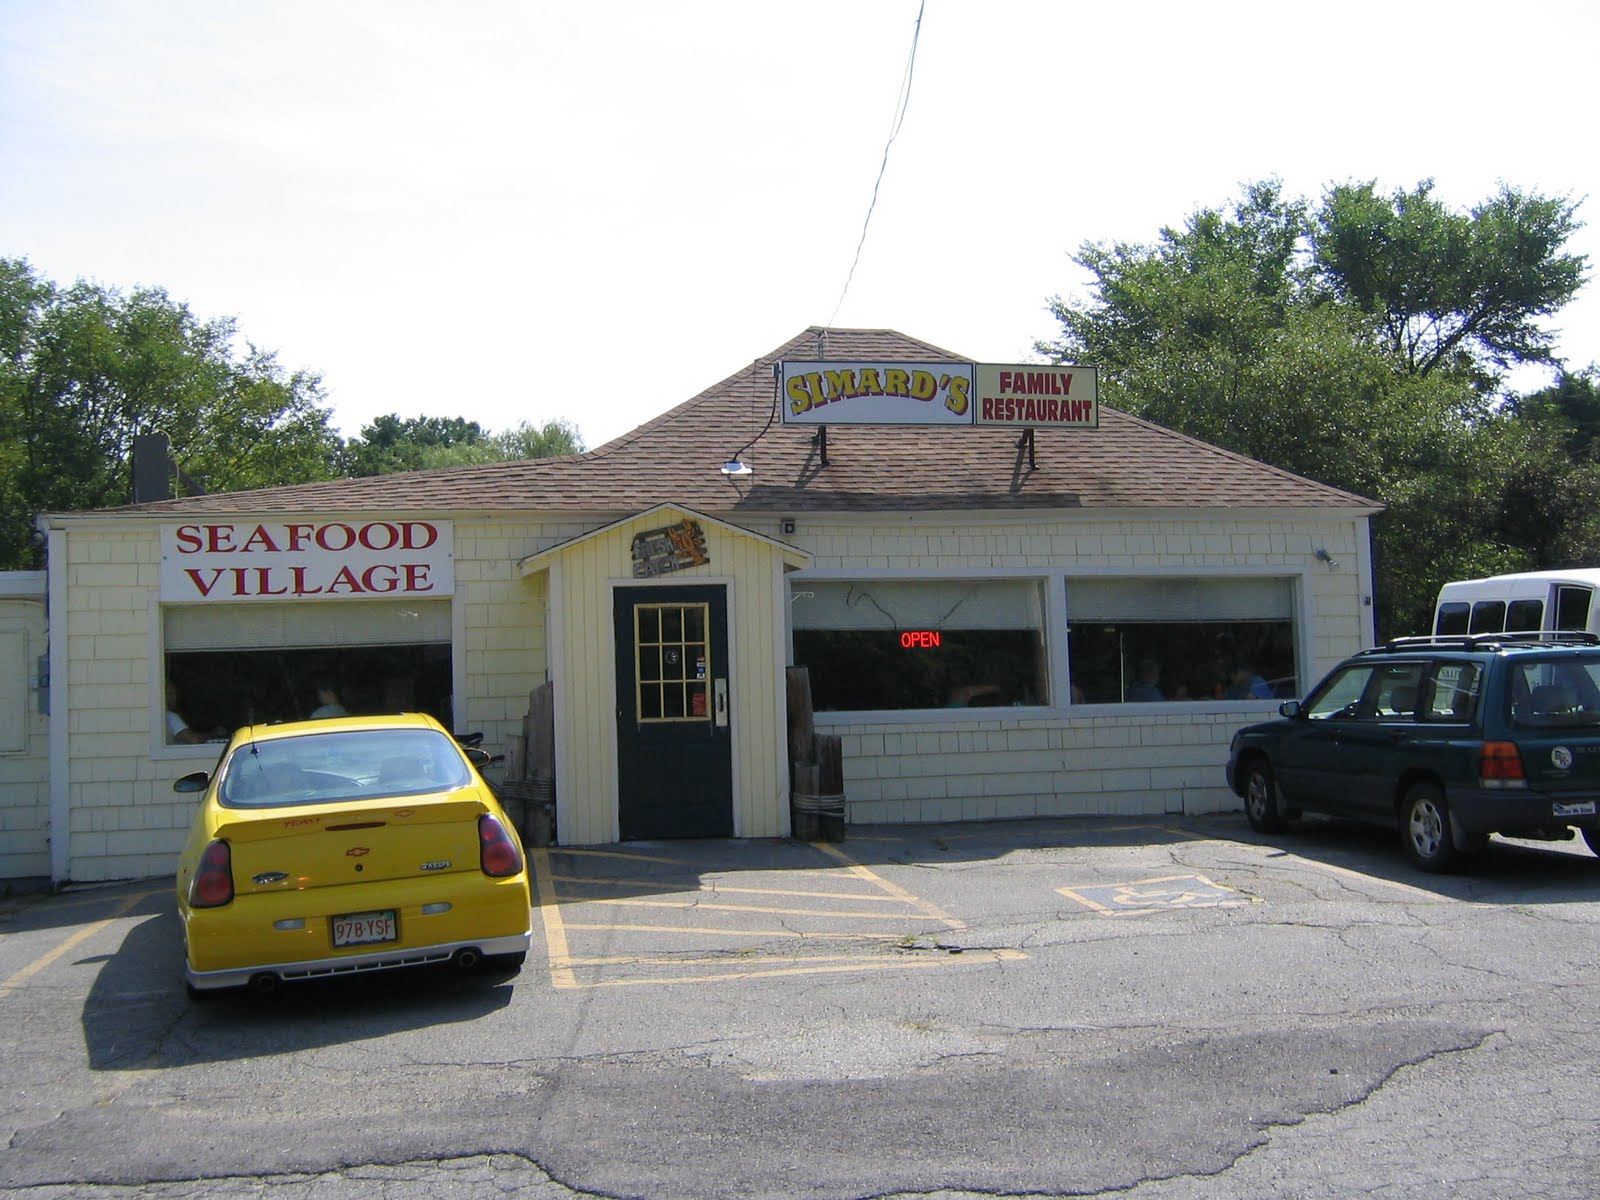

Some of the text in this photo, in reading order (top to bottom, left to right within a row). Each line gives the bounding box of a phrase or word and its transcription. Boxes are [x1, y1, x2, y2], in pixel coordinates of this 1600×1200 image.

[786, 368, 970, 416] SIMARD'S
[999, 371, 1073, 395] FAMILY
[982, 397, 1093, 422] RESTAURANT
[176, 522, 438, 554] SEAFOOD
[184, 564, 434, 597] VILLAGE
[901, 631, 940, 648] OPEN
